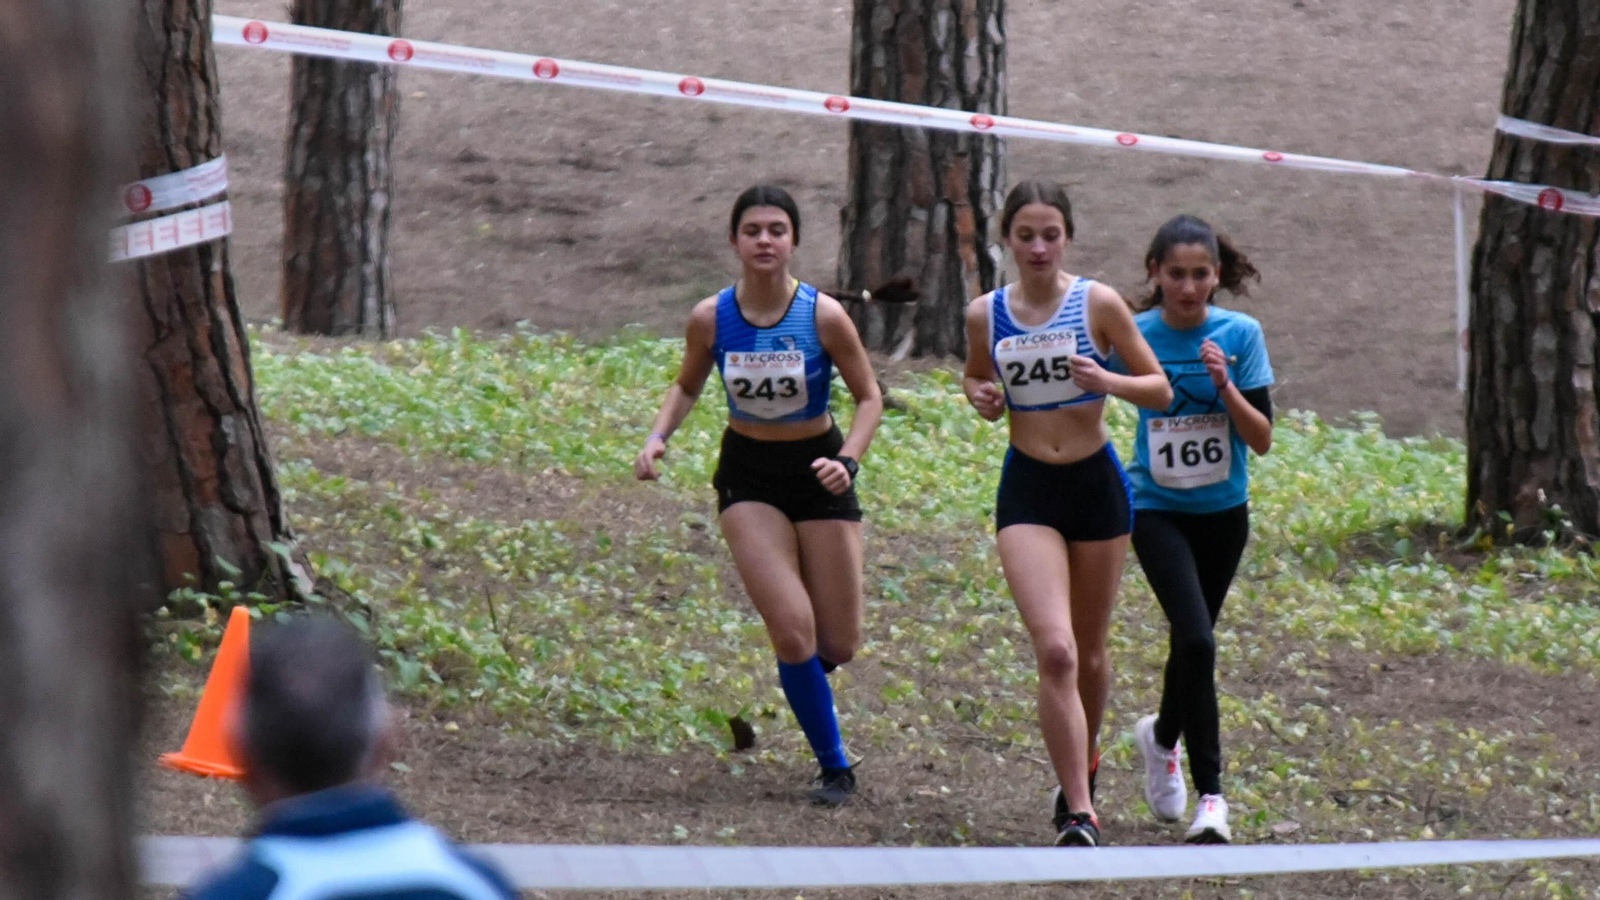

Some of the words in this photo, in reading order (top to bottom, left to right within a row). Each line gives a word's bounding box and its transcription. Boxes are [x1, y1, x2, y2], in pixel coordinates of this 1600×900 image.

[1016, 331, 1073, 346] IV-CROSS
[743, 353, 802, 363] IV-CROSS
[1006, 355, 1072, 386] 245
[733, 376, 799, 401] 243
[1158, 437, 1224, 468] 166
